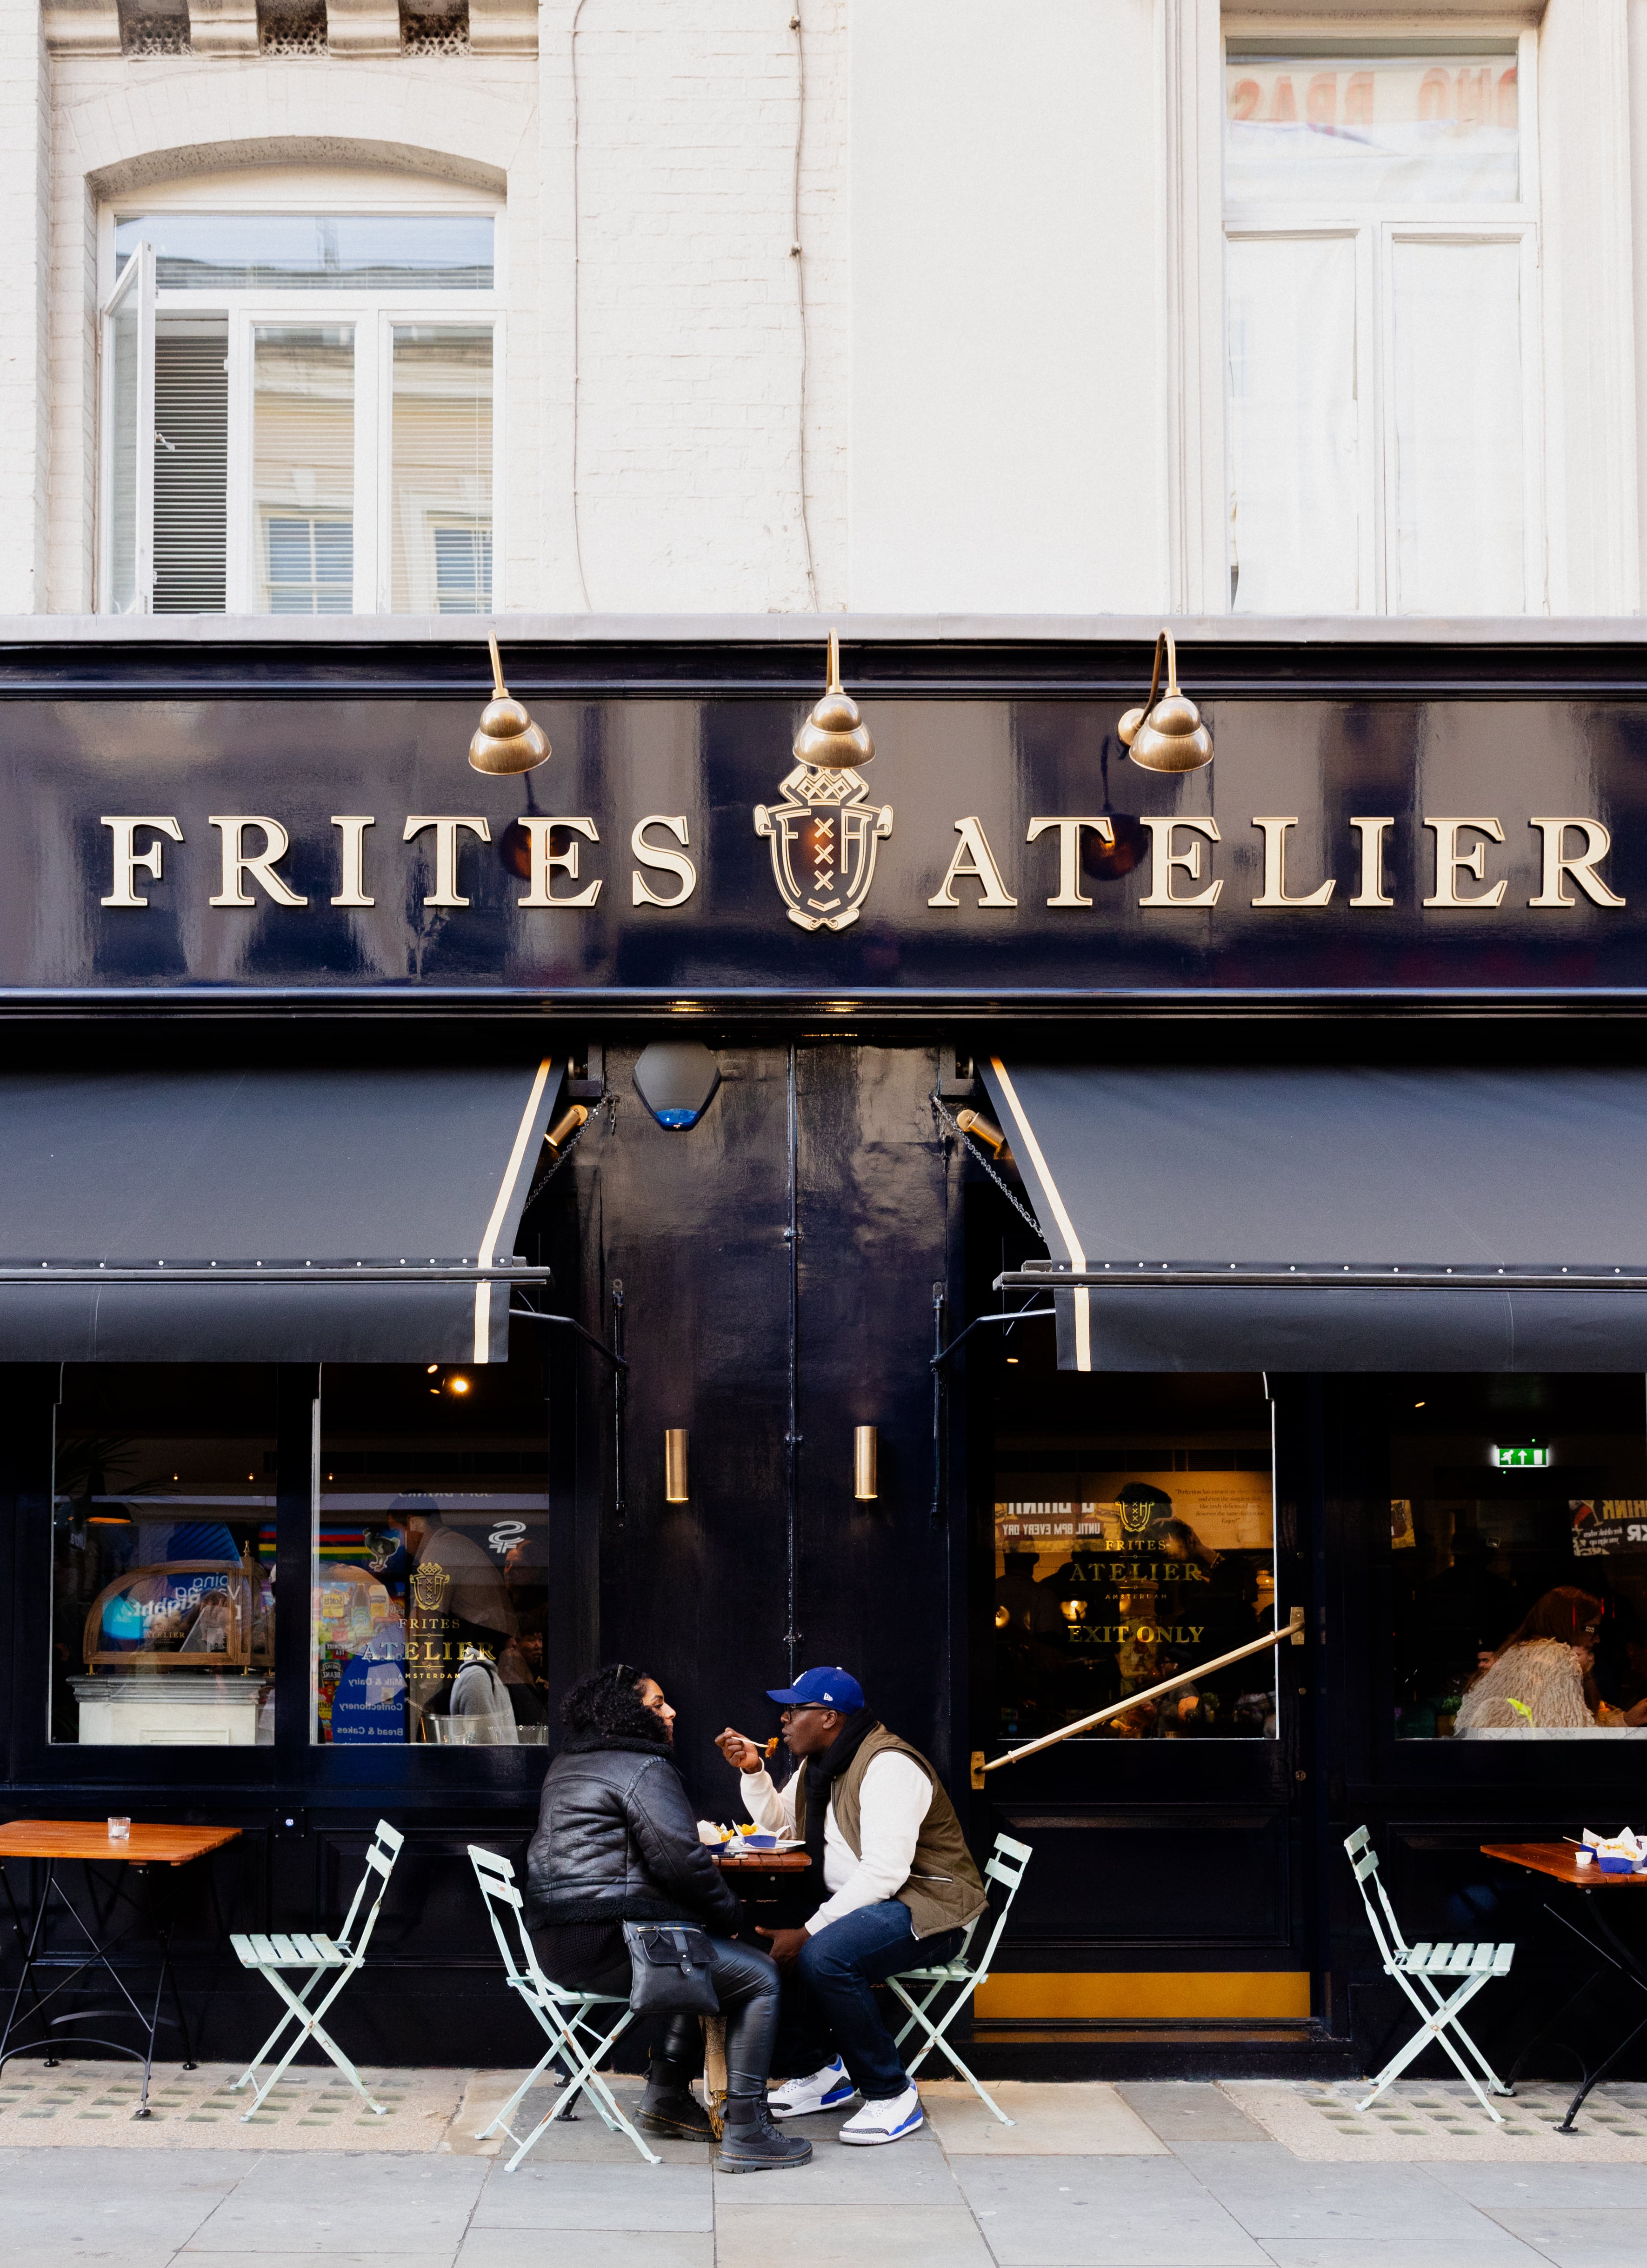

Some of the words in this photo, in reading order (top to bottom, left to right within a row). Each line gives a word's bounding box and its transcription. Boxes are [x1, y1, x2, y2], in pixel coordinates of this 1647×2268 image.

[100, 816, 697, 907] FRITES
[928, 816, 1626, 907] ATELIER
[1105, 1540, 1167, 1550] FRITES
[1069, 1563, 1202, 1581] ATELIER
[399, 1619, 460, 1629] FRITES
[1067, 1626, 1130, 1643] EXIT
[1136, 1626, 1205, 1643] ONLY
[361, 1641, 496, 1661] ATELIER
